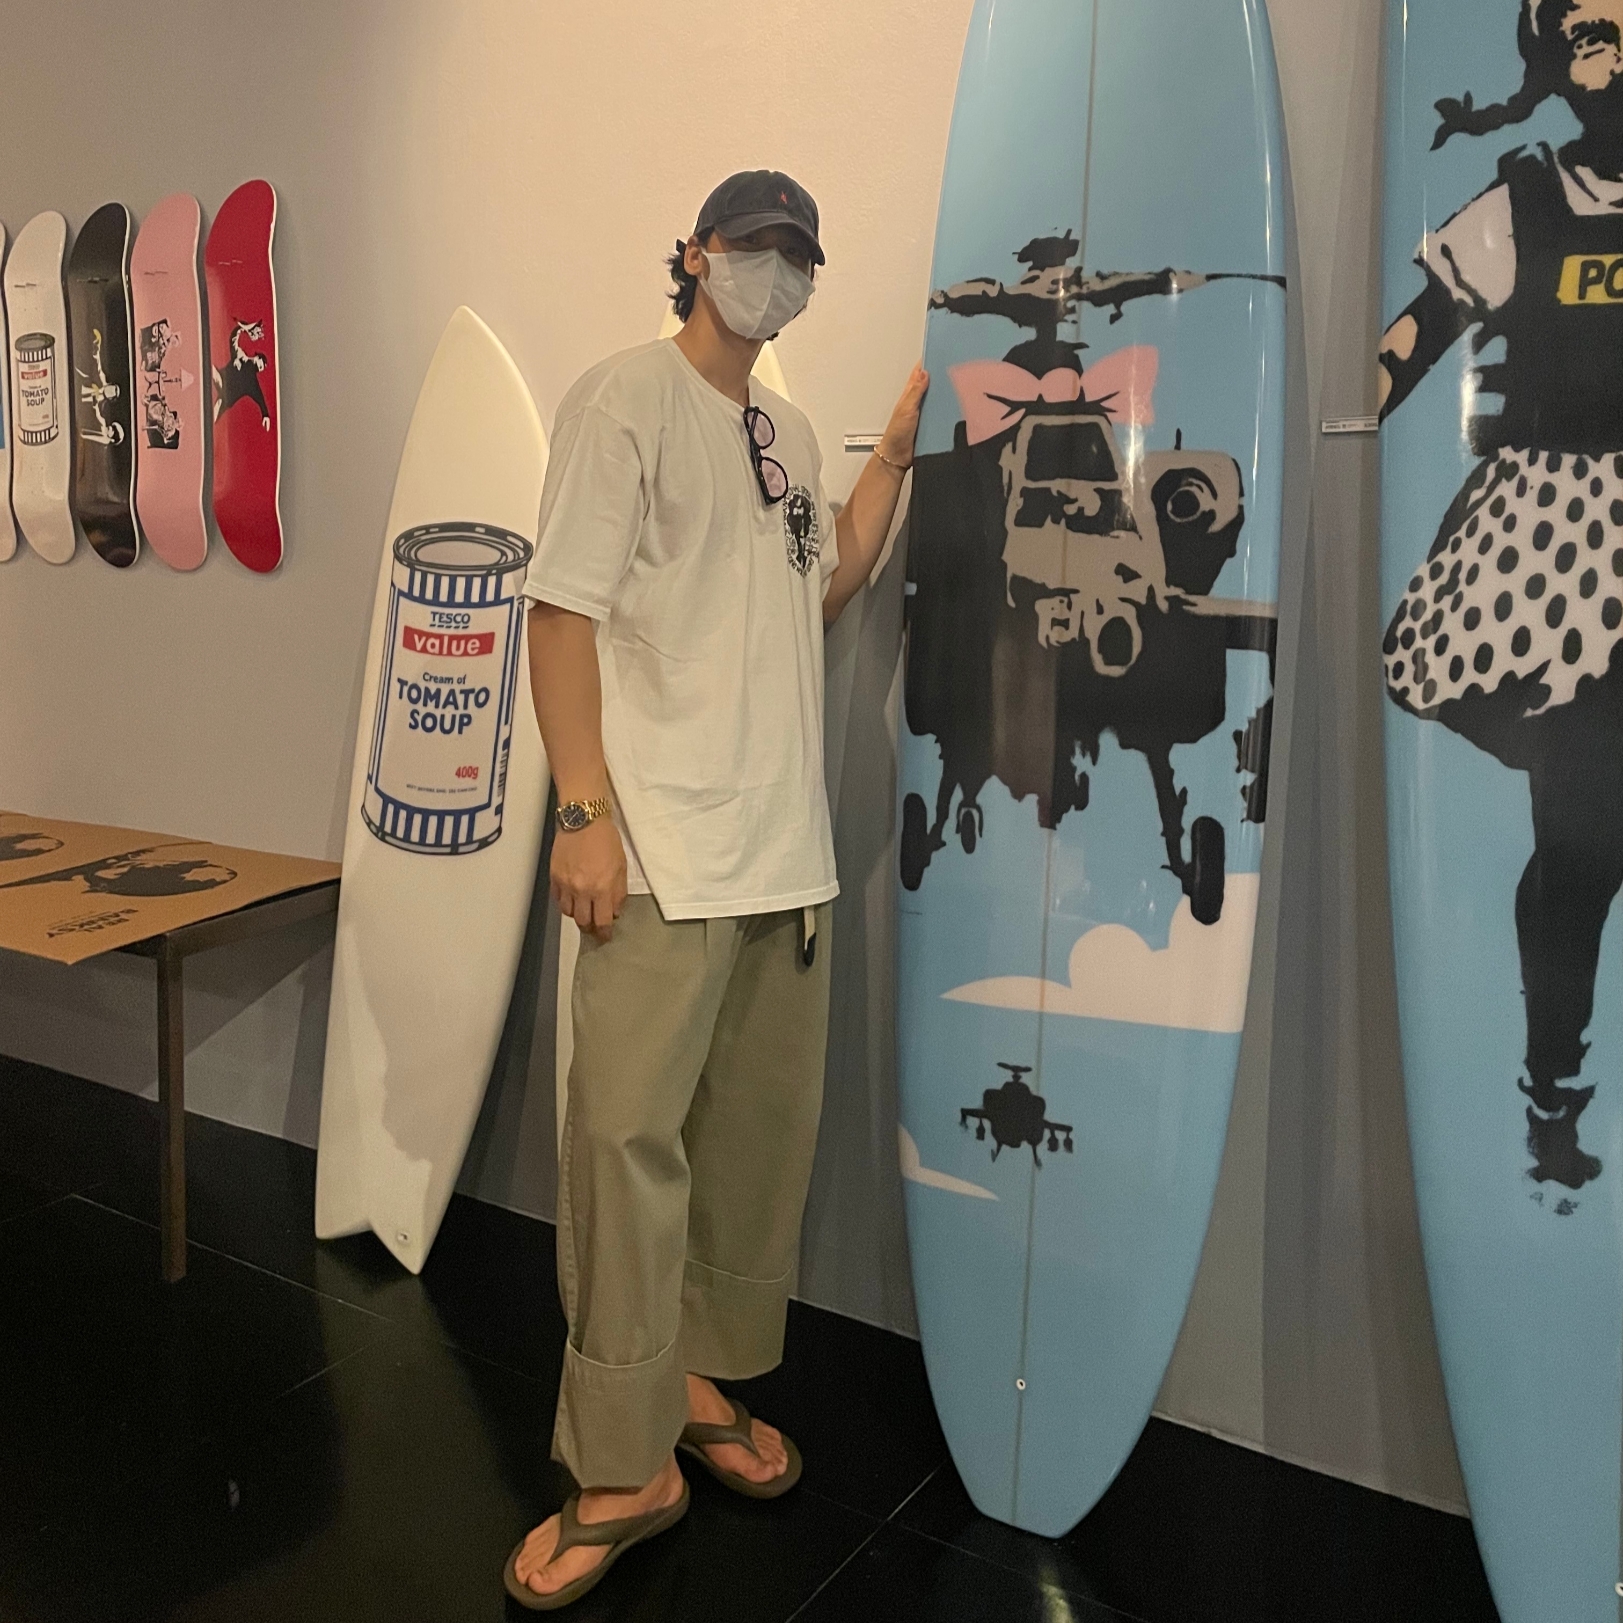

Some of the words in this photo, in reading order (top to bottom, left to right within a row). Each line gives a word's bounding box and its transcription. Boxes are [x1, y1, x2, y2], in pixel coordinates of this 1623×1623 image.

[21, 388, 49, 398] TOMATO
[27, 397, 45, 407] SOUP
[430, 611, 471, 625] TESCO
[414, 633, 480, 656] value
[422, 672, 453, 685] Cream
[456, 674, 467, 685] of
[397, 677, 490, 710] TOMATO
[408, 709, 472, 735] SOUP
[455, 765, 479, 780] 400g
